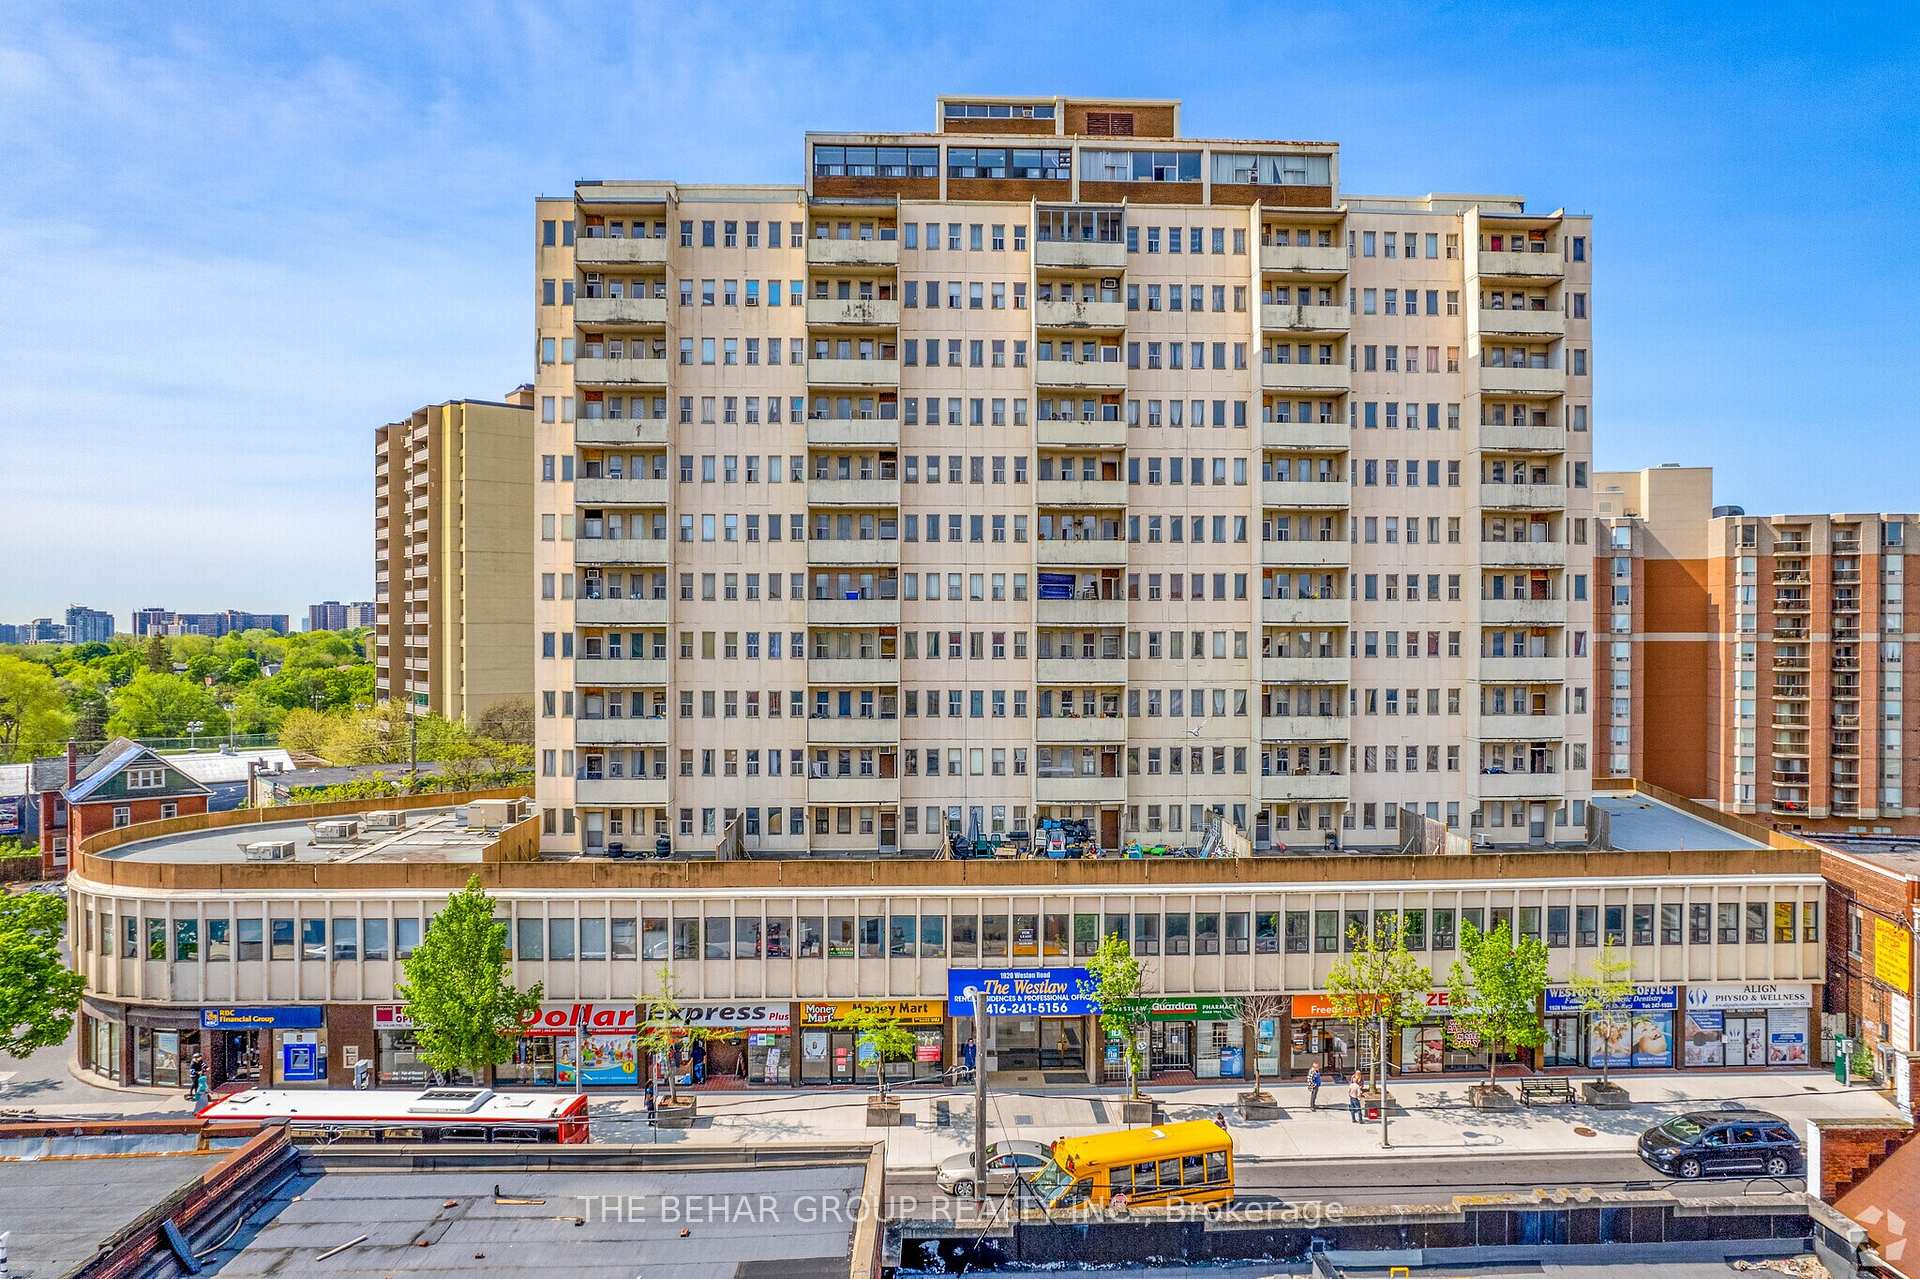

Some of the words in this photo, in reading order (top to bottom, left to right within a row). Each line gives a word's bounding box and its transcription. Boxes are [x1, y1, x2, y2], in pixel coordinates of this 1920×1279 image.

[1036, 971, 1050, 979] Road
[984, 980, 1010, 994] The
[1014, 979, 1067, 994] Westlaw
[1637, 986, 1674, 996] OFFICE
[1743, 985, 1777, 993] ALIGN
[1023, 993, 1070, 1002] PROFESSIONAL
[1633, 995, 1663, 1003] Dentistry
[1715, 994, 1749, 1002] PHYSIO
[805, 1004, 837, 1015] Money
[852, 1003, 896, 1016] Money
[899, 1002, 928, 1013] Mart
[986, 1003, 1068, 1014] 416-241-5156
[1151, 1002, 1197, 1011] Guardian
[518, 1003, 635, 1026] Dollar
[648, 1003, 766, 1026] Express
[768, 1012, 790, 1021] Plus
[807, 1013, 834, 1023] Mart
